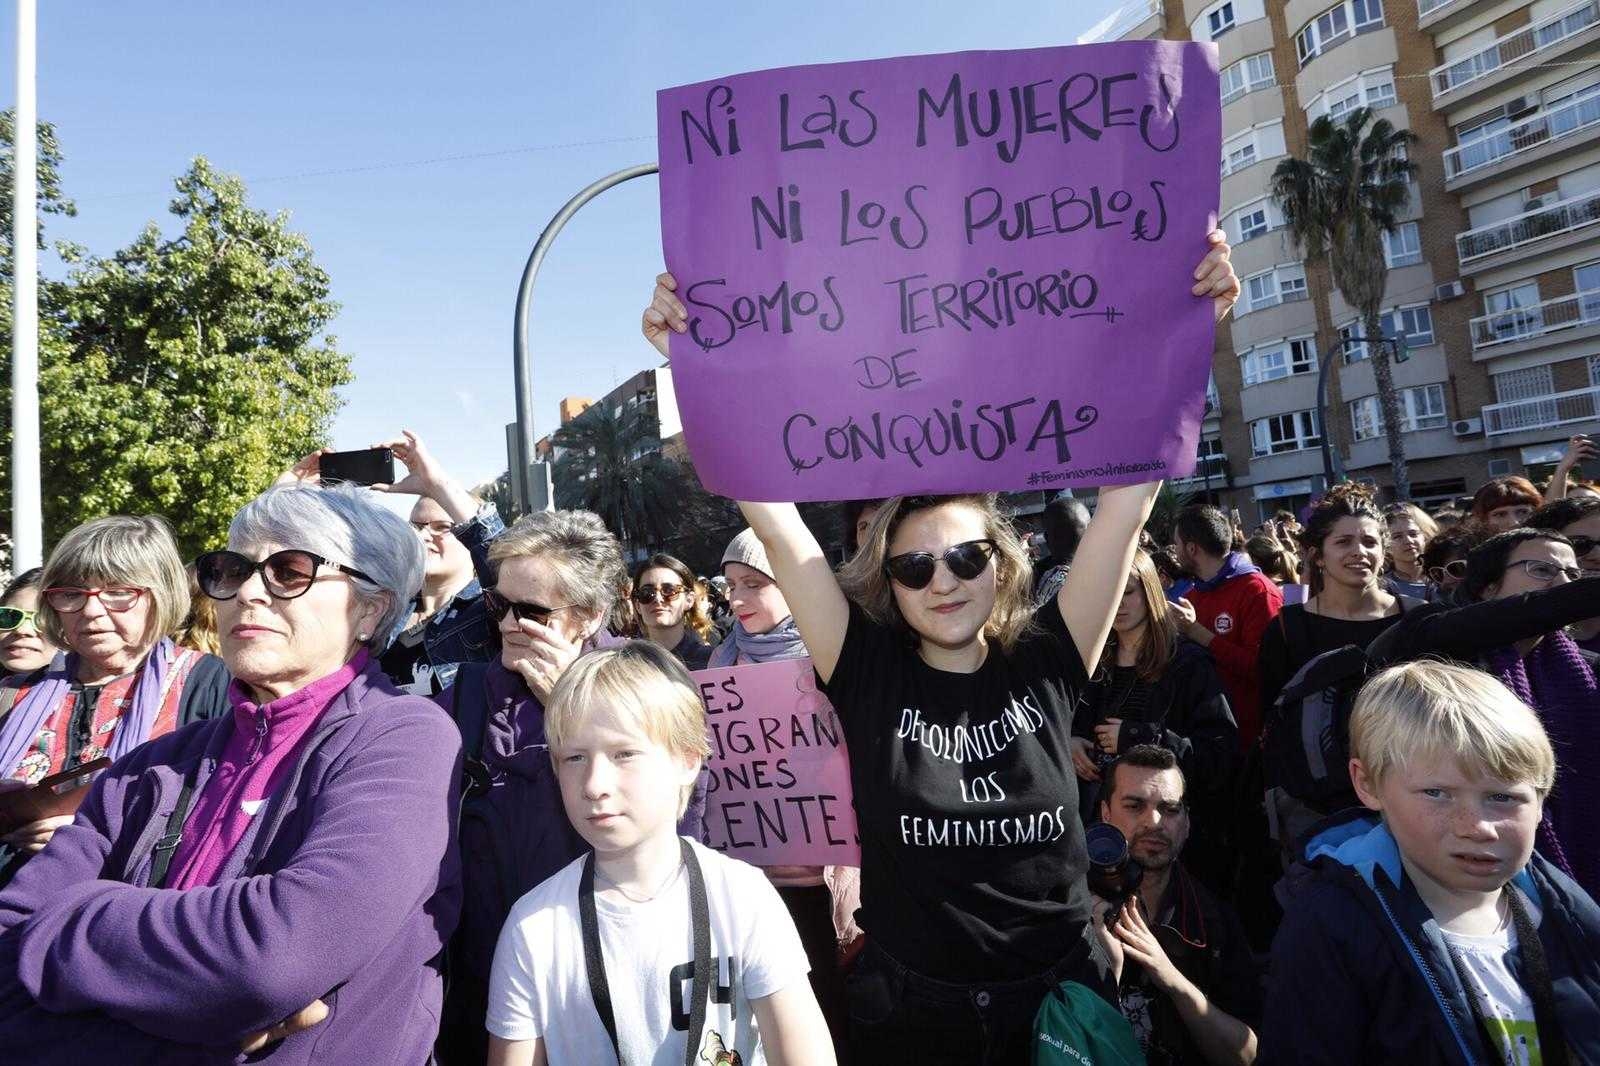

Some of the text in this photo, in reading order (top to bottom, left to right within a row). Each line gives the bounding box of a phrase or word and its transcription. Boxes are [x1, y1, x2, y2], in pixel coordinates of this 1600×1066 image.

[681, 85, 741, 164] Ni
[916, 73, 1179, 163] MUJERES
[752, 184, 803, 249] Ni
[853, 348, 922, 389] DE
[700, 676, 743, 714] ES
[708, 711, 840, 760] IGRAN
[959, 771, 1005, 802] LOS
[702, 795, 862, 850] LENTE
[900, 806, 1064, 846] FEMINISMOS
[1063, 1045, 1081, 1060] para
